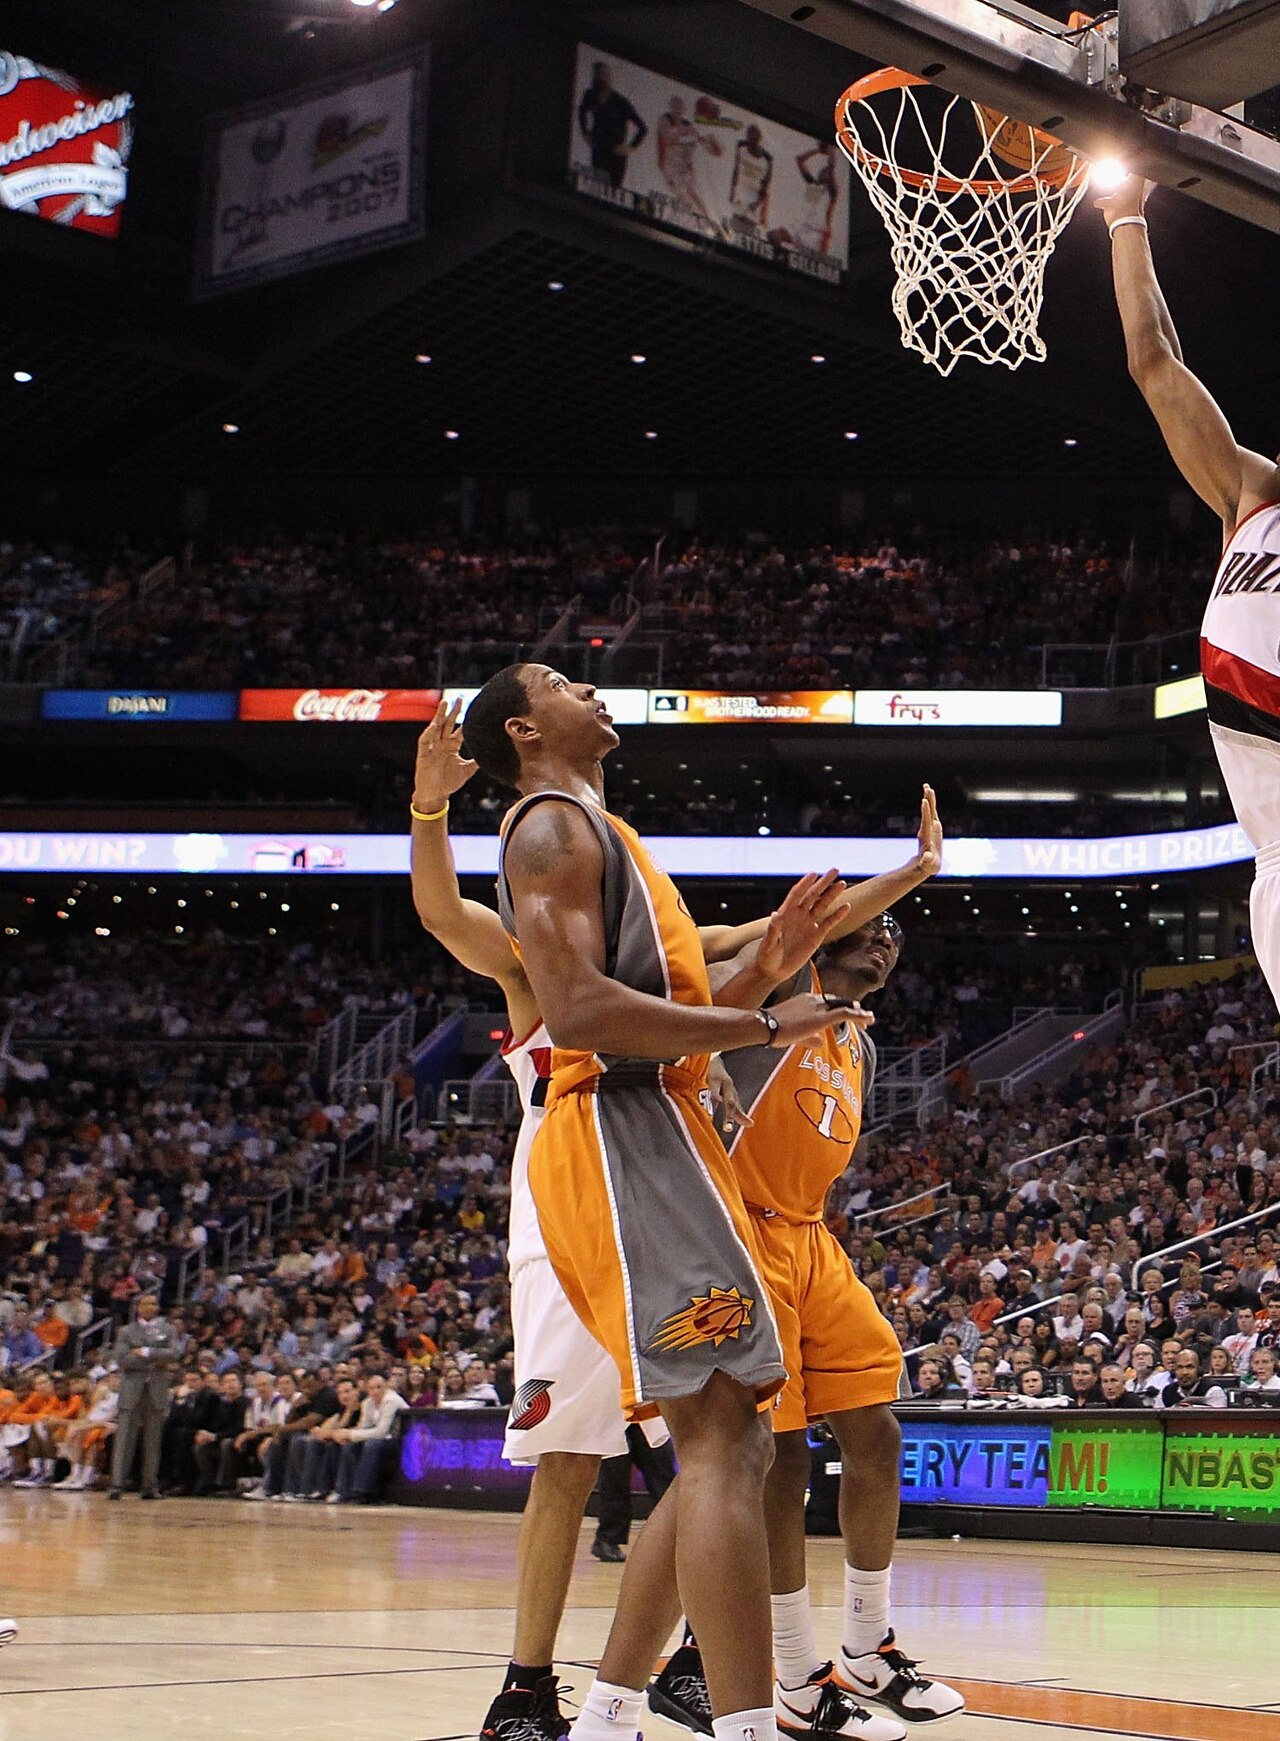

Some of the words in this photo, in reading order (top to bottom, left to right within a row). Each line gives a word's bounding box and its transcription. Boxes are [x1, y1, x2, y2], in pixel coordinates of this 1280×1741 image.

[221, 161, 401, 233] CHAMPIONS
[704, 705, 776, 718] BROTHERHOOD
[888, 693, 941, 721] fry's
[52, 837, 148, 866] WIN?
[1023, 839, 1147, 871] WHICH
[1159, 828, 1248, 865] PRIZE
[799, 1048, 831, 1082] LOS
[817, 1094, 838, 1140] 1
[977, 1439, 1111, 1494] TEAM!
